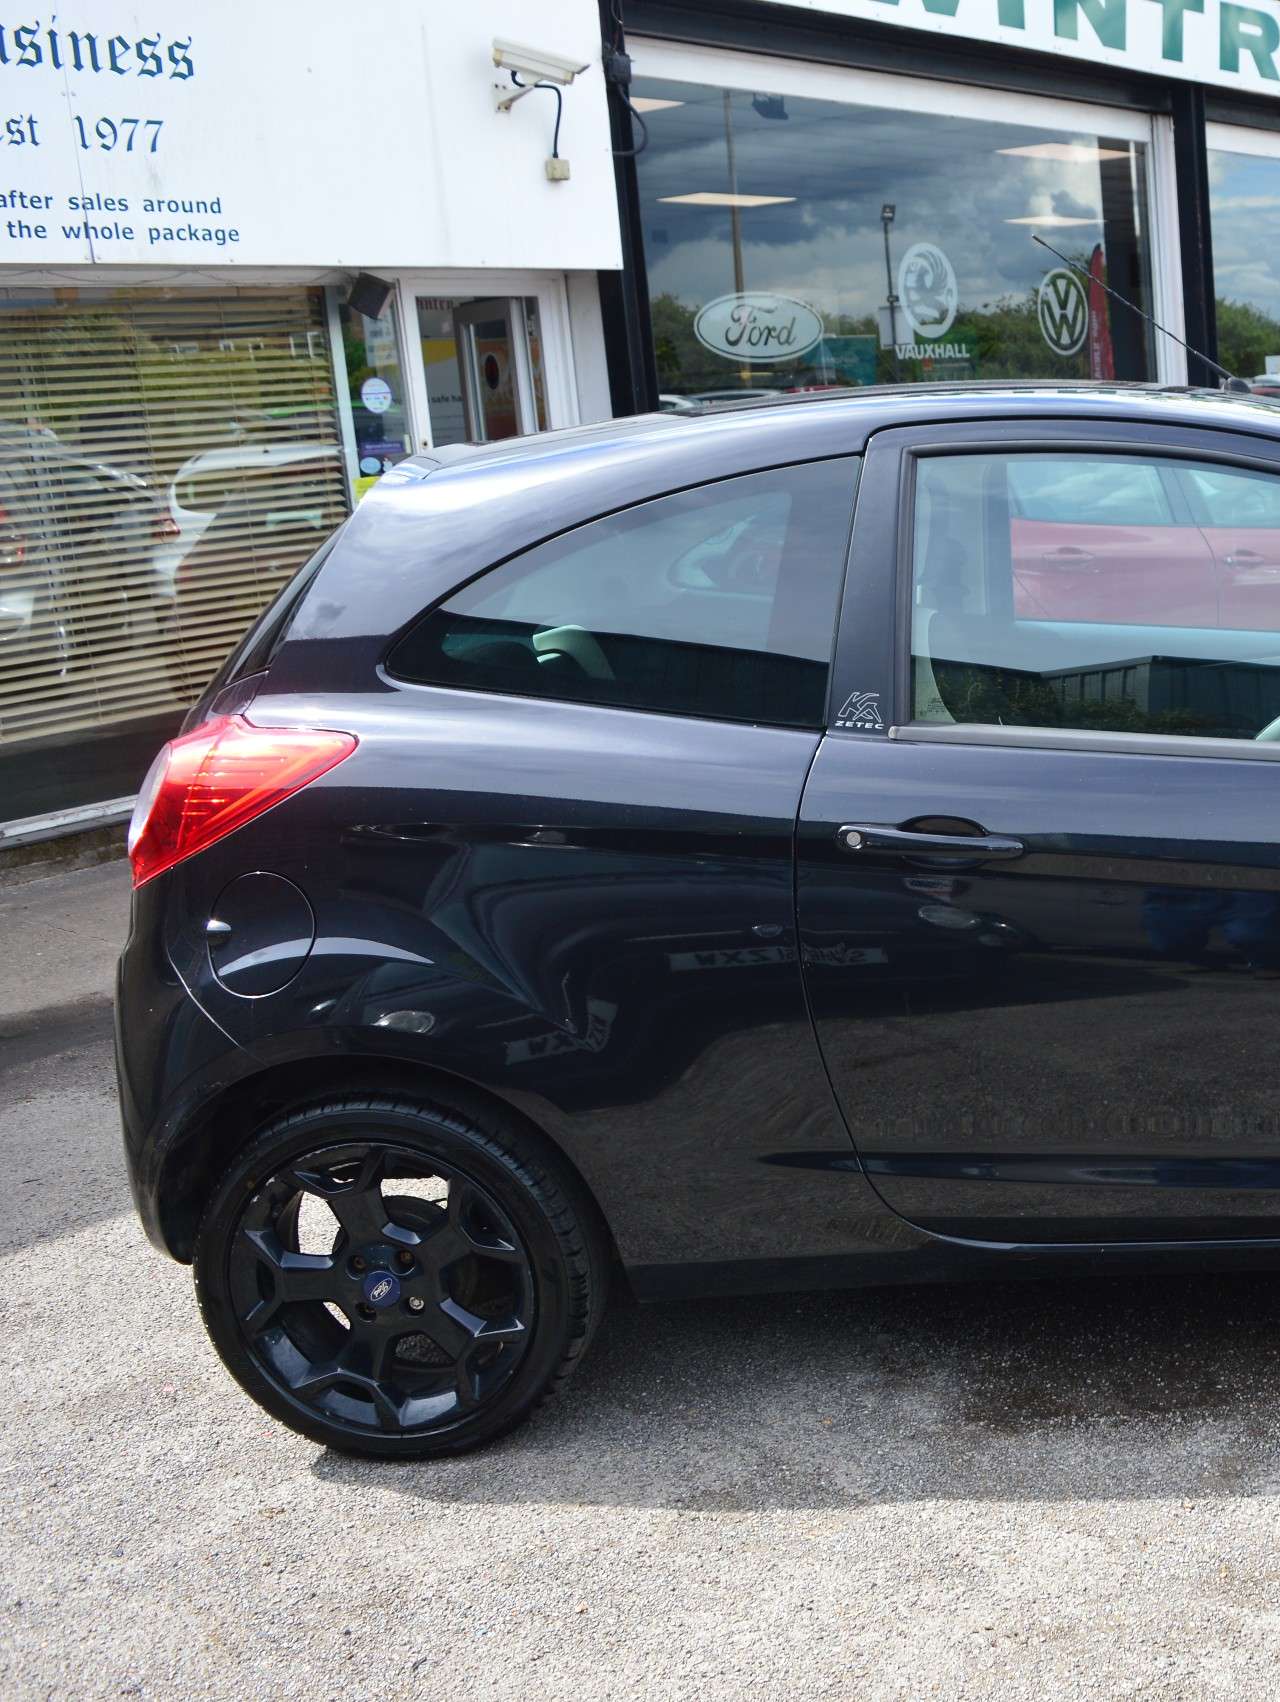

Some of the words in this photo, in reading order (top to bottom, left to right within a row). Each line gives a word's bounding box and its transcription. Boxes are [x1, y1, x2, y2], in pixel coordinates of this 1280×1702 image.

[0, 113, 40, 147] st
[73, 115, 164, 152] 1977
[0, 190, 53, 210] after
[68, 193, 129, 211] sales
[143, 197, 222, 214] around
[7, 220, 48, 239] the
[62, 222, 135, 240] whole
[149, 224, 240, 246] package
[725, 303, 797, 347] Ford
[895, 343, 970, 360] VAUXHALL
[835, 720, 885, 730] ZETEC
